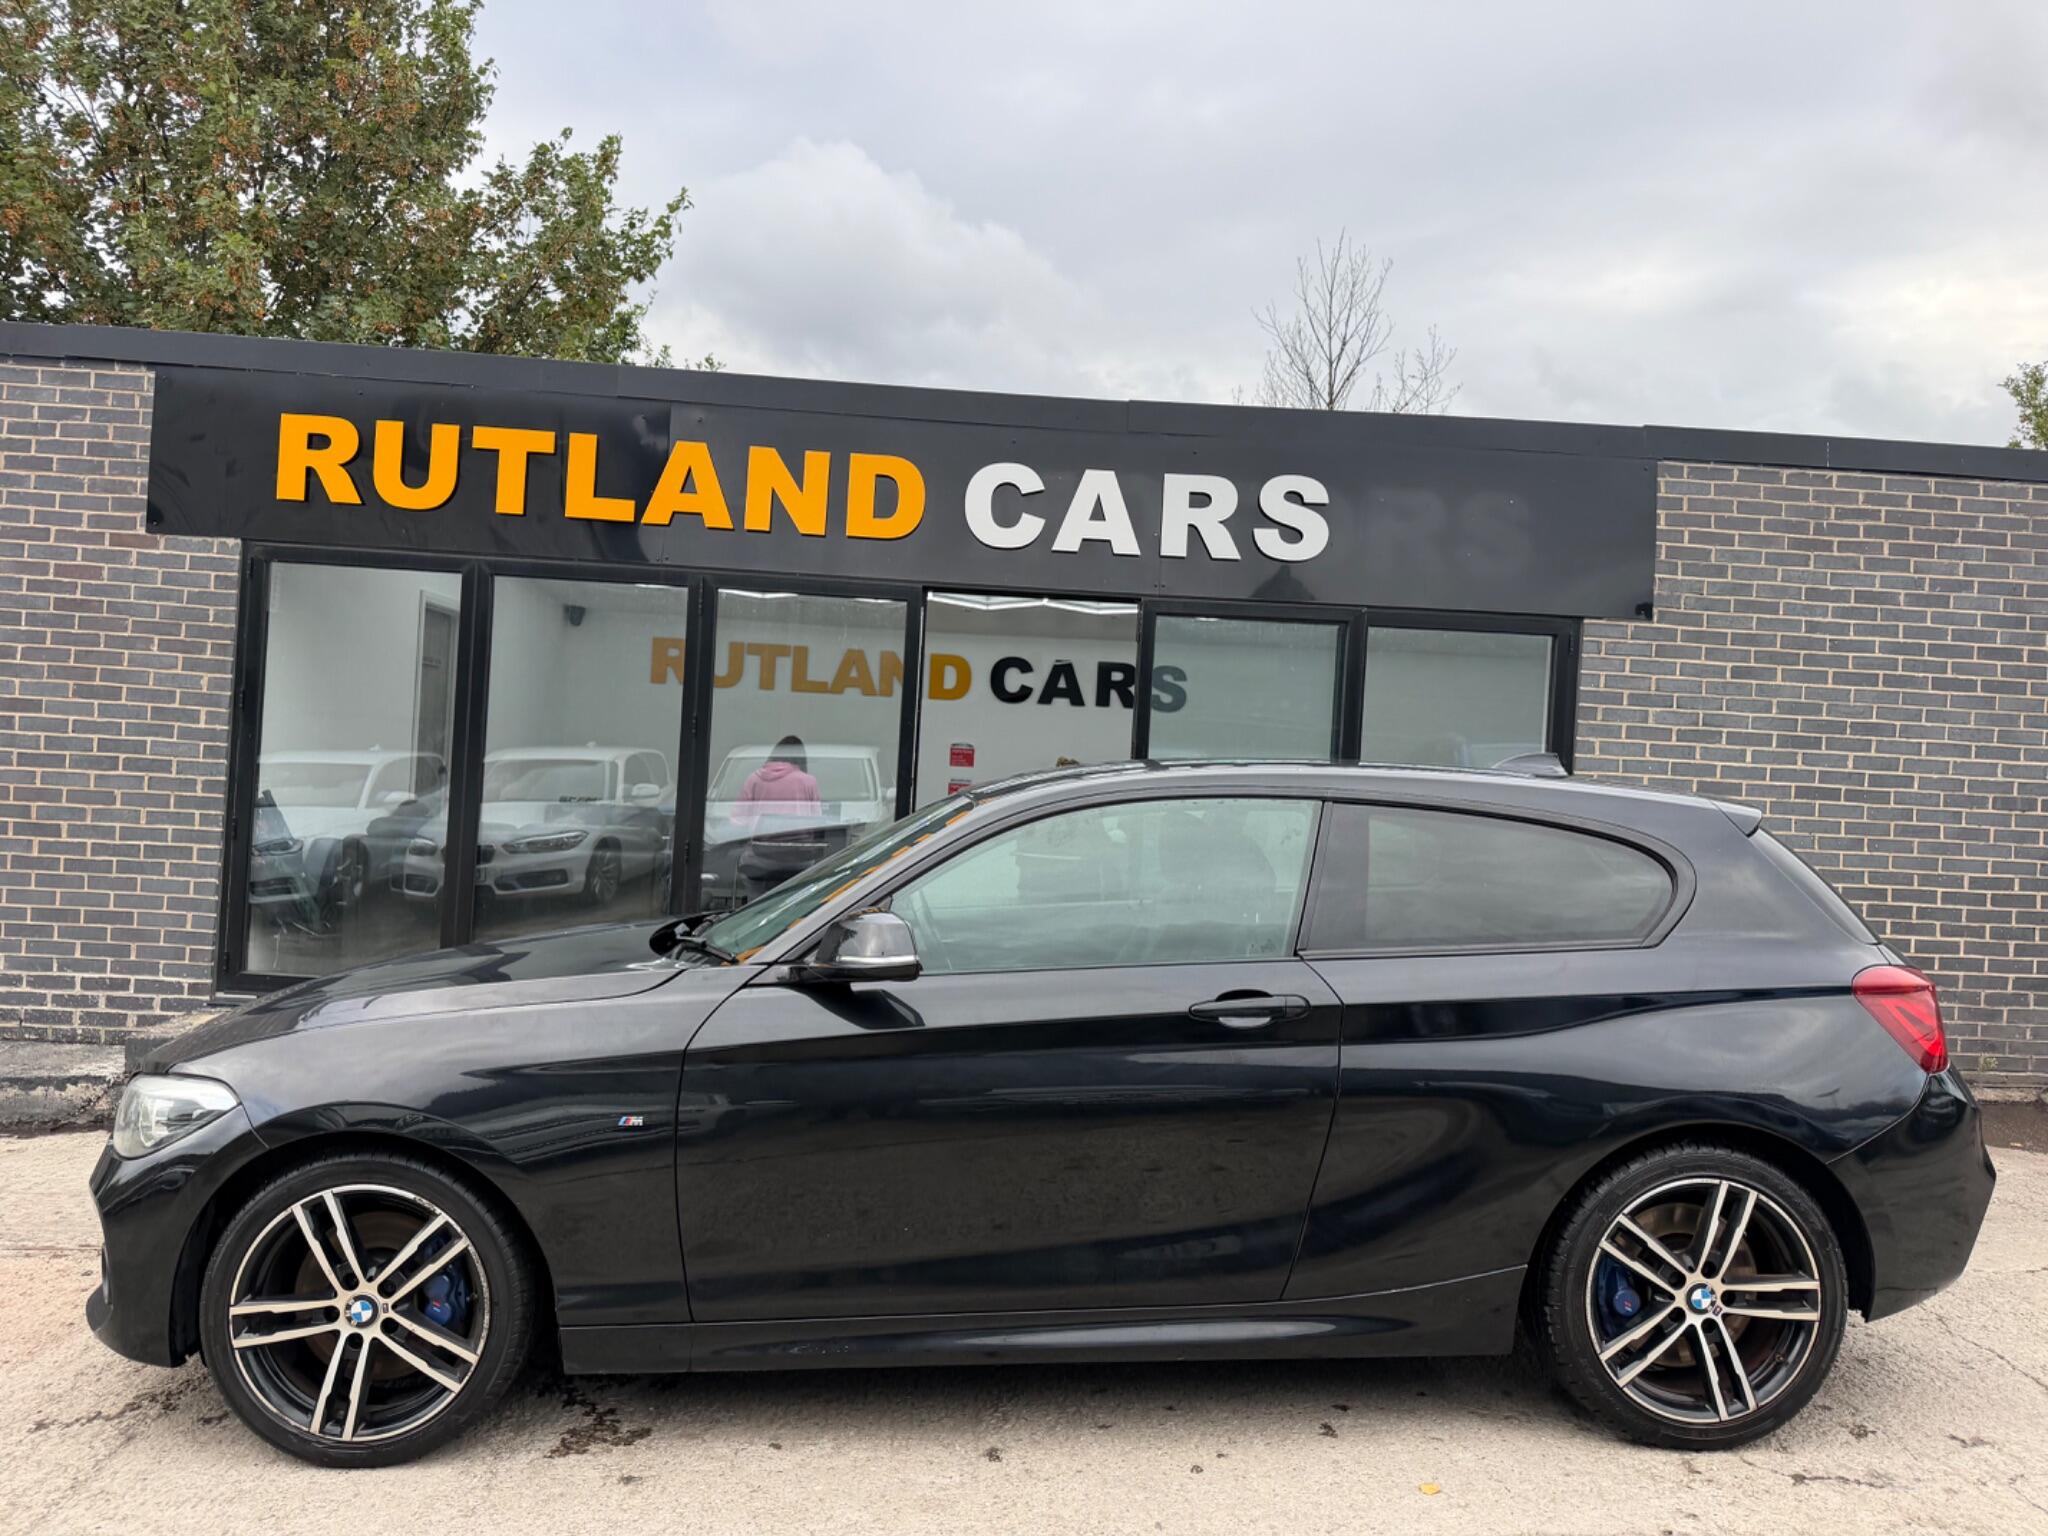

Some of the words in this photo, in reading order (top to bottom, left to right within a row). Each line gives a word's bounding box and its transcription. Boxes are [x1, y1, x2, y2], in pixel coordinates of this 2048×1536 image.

[276, 413, 926, 539] RUTLAND
[964, 462, 1331, 561] CARS
[650, 636, 972, 701] RUTLAND
[990, 656, 1188, 713] CARS
